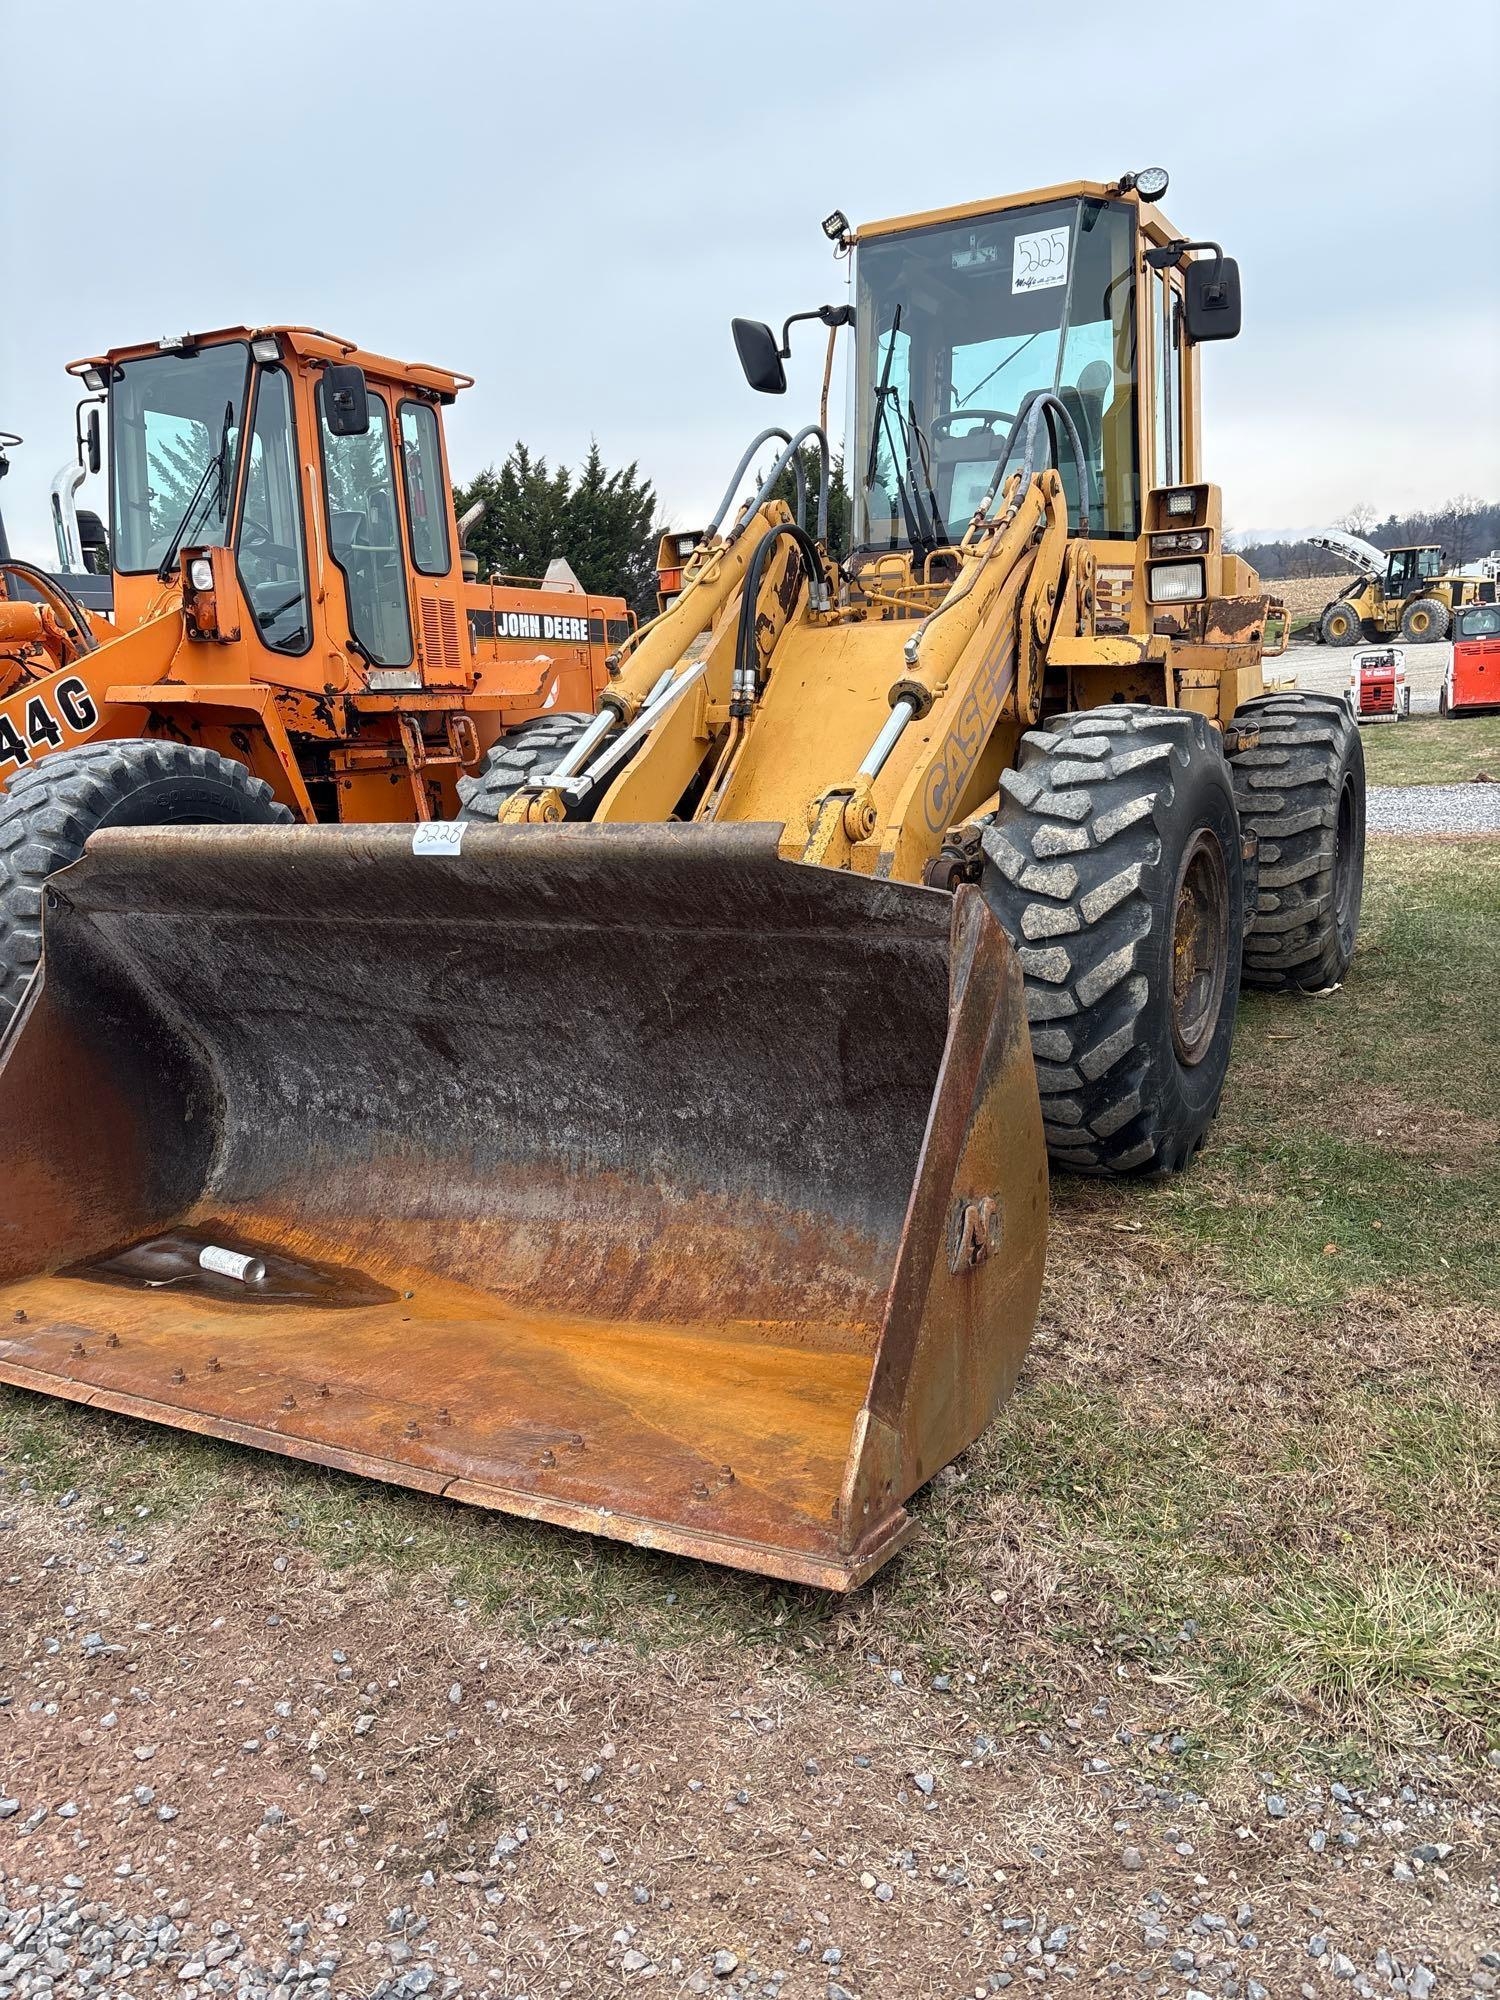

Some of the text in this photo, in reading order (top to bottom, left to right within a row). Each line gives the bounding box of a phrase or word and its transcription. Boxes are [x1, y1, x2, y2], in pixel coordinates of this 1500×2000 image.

[1018, 231, 1065, 275] 5225
[497, 613, 588, 641] JOHN DEERE
[924, 664, 999, 834] CASE
